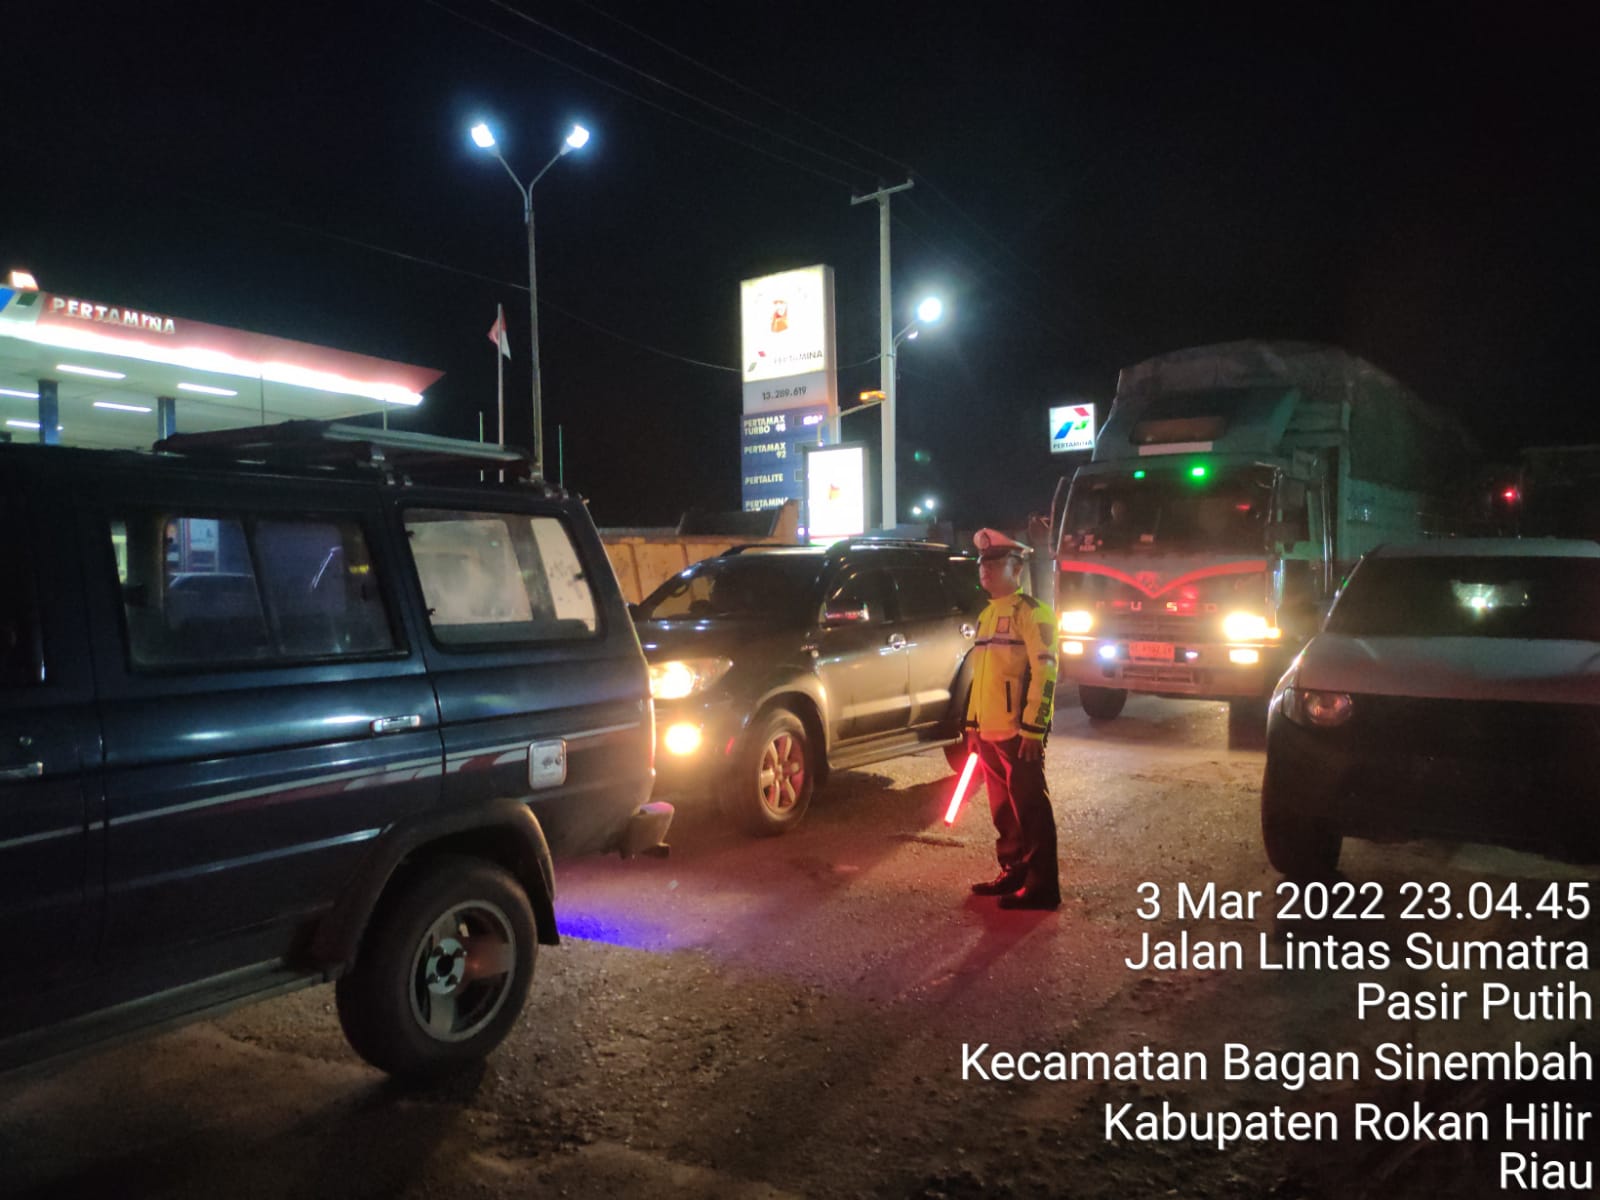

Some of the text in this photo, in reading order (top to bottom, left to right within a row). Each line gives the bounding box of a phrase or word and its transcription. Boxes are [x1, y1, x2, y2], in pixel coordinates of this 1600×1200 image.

[52, 297, 176, 334] PERTAMINA
[772, 349, 823, 366] TMINA
[743, 415, 786, 427] PERTAMAX
[744, 425, 771, 436] TURBO
[743, 442, 787, 455] PERTAMAX
[744, 473, 784, 486] PERTALITE
